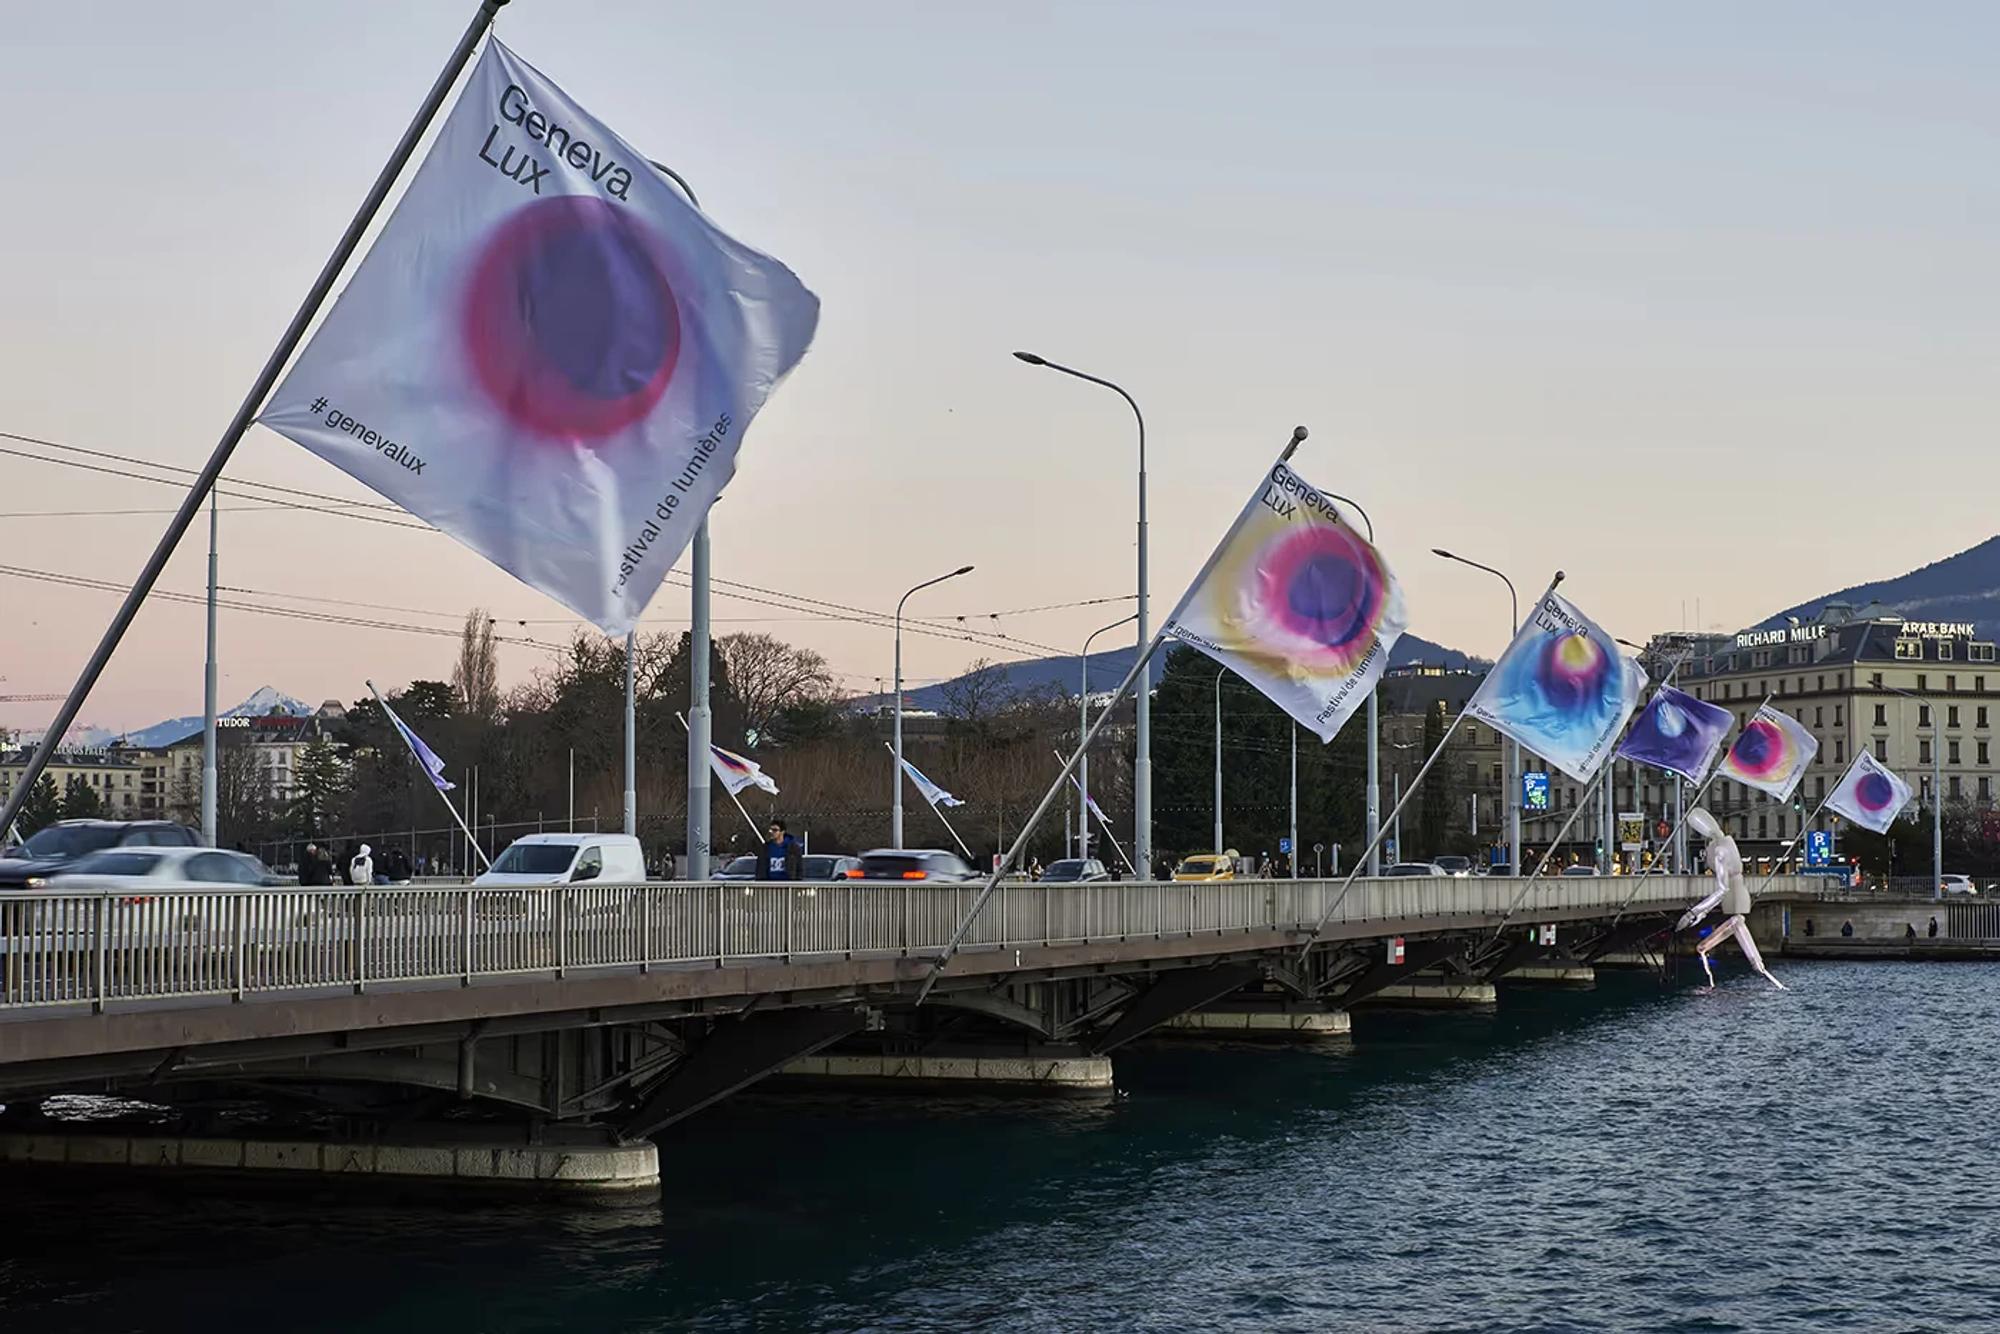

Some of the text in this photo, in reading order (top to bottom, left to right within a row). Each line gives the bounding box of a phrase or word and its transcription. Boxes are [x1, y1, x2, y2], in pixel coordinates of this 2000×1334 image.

[478, 124, 550, 195] Lux
[499, 84, 633, 201] Geneva
[324, 409, 427, 476] genevalux
[655, 493, 680, 521] de
[671, 411, 732, 493] lumières
[1262, 485, 1297, 521] Lux
[1271, 464, 1338, 524] Geneva
[1535, 611, 1560, 636] Lux
[1544, 598, 1589, 639] Geneva
[1736, 625, 1827, 648] RICHARD MILLE
[1901, 621, 1937, 634] ARAB
[1939, 622, 1975, 636] BANK
[216, 717, 251, 728] TUDOR
[1316, 685, 1349, 724] Festival
[1, 742, 22, 753] Bank
